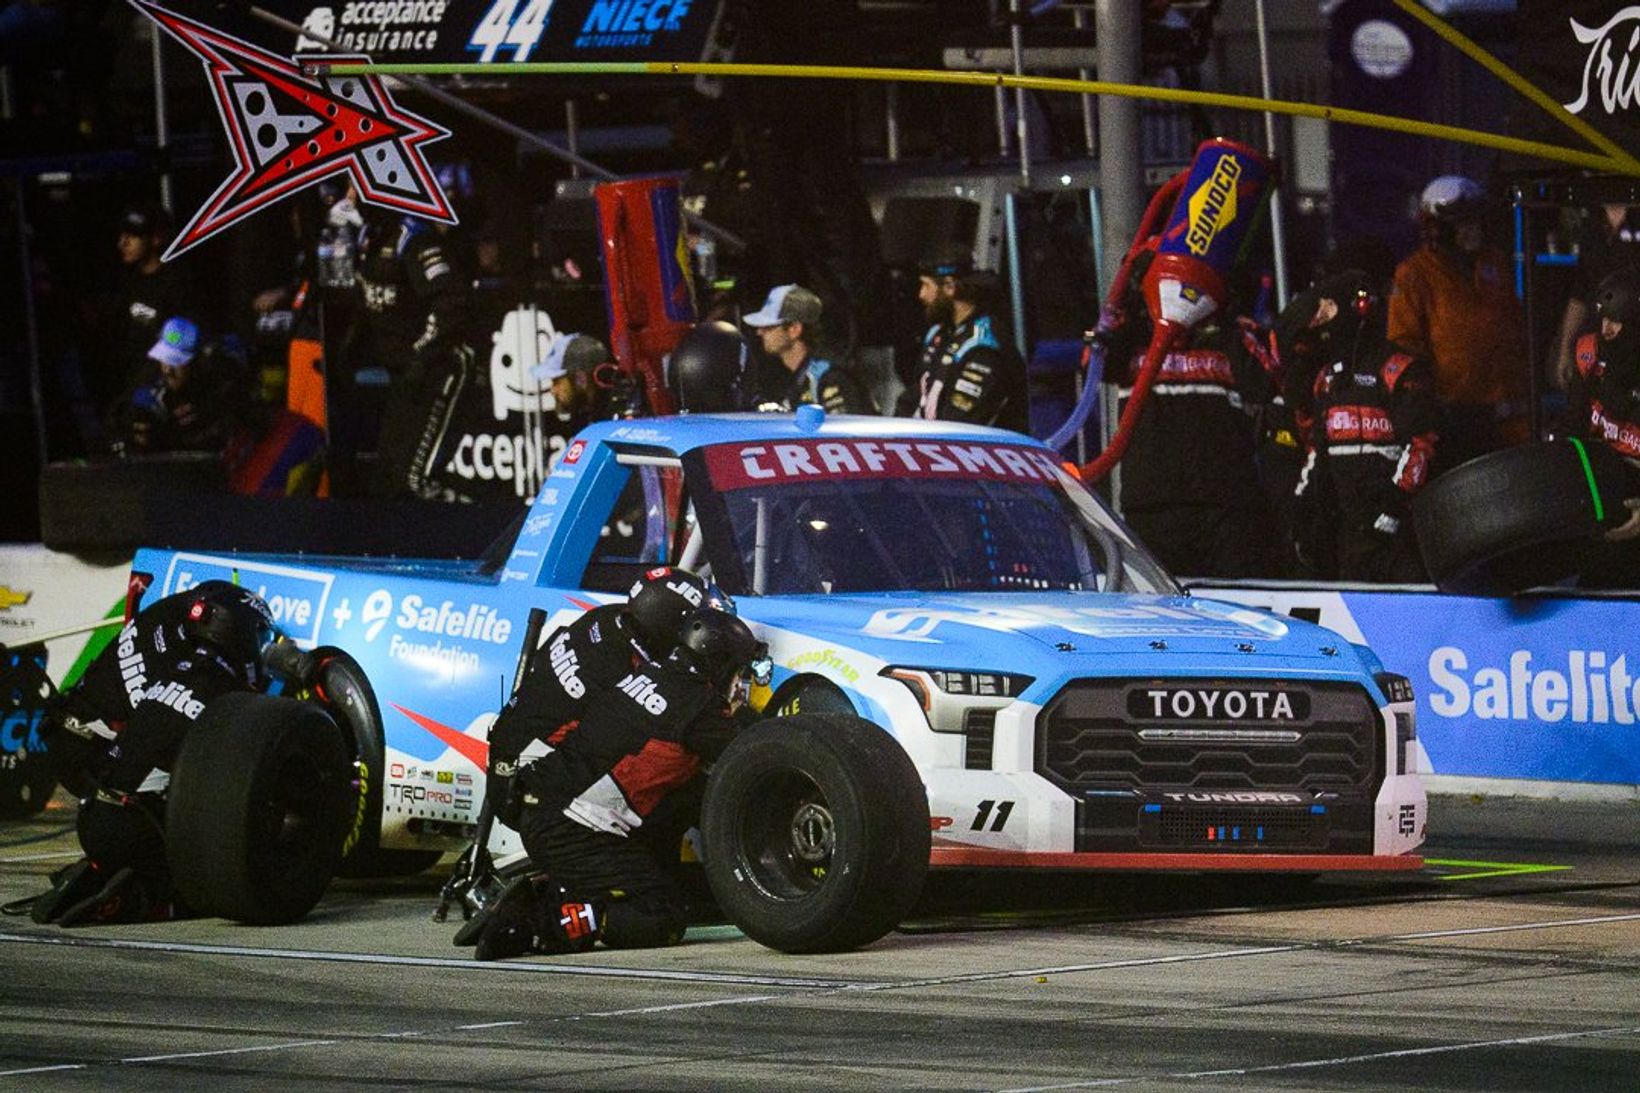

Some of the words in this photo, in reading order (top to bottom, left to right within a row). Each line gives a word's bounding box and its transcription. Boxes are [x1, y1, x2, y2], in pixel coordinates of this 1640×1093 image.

[336, 28, 438, 51] insurance
[470, 0, 552, 62] 44
[1563, 5, 1640, 114] Tri
[1188, 156, 1240, 252] SUNOCO
[396, 594, 512, 644] Safelite
[389, 634, 481, 673] Foundation
[1148, 690, 1294, 719] TOYOTA
[1428, 645, 1640, 725] Safelit
[969, 799, 1016, 832] 11
[1163, 791, 1303, 803] TUNDRA
